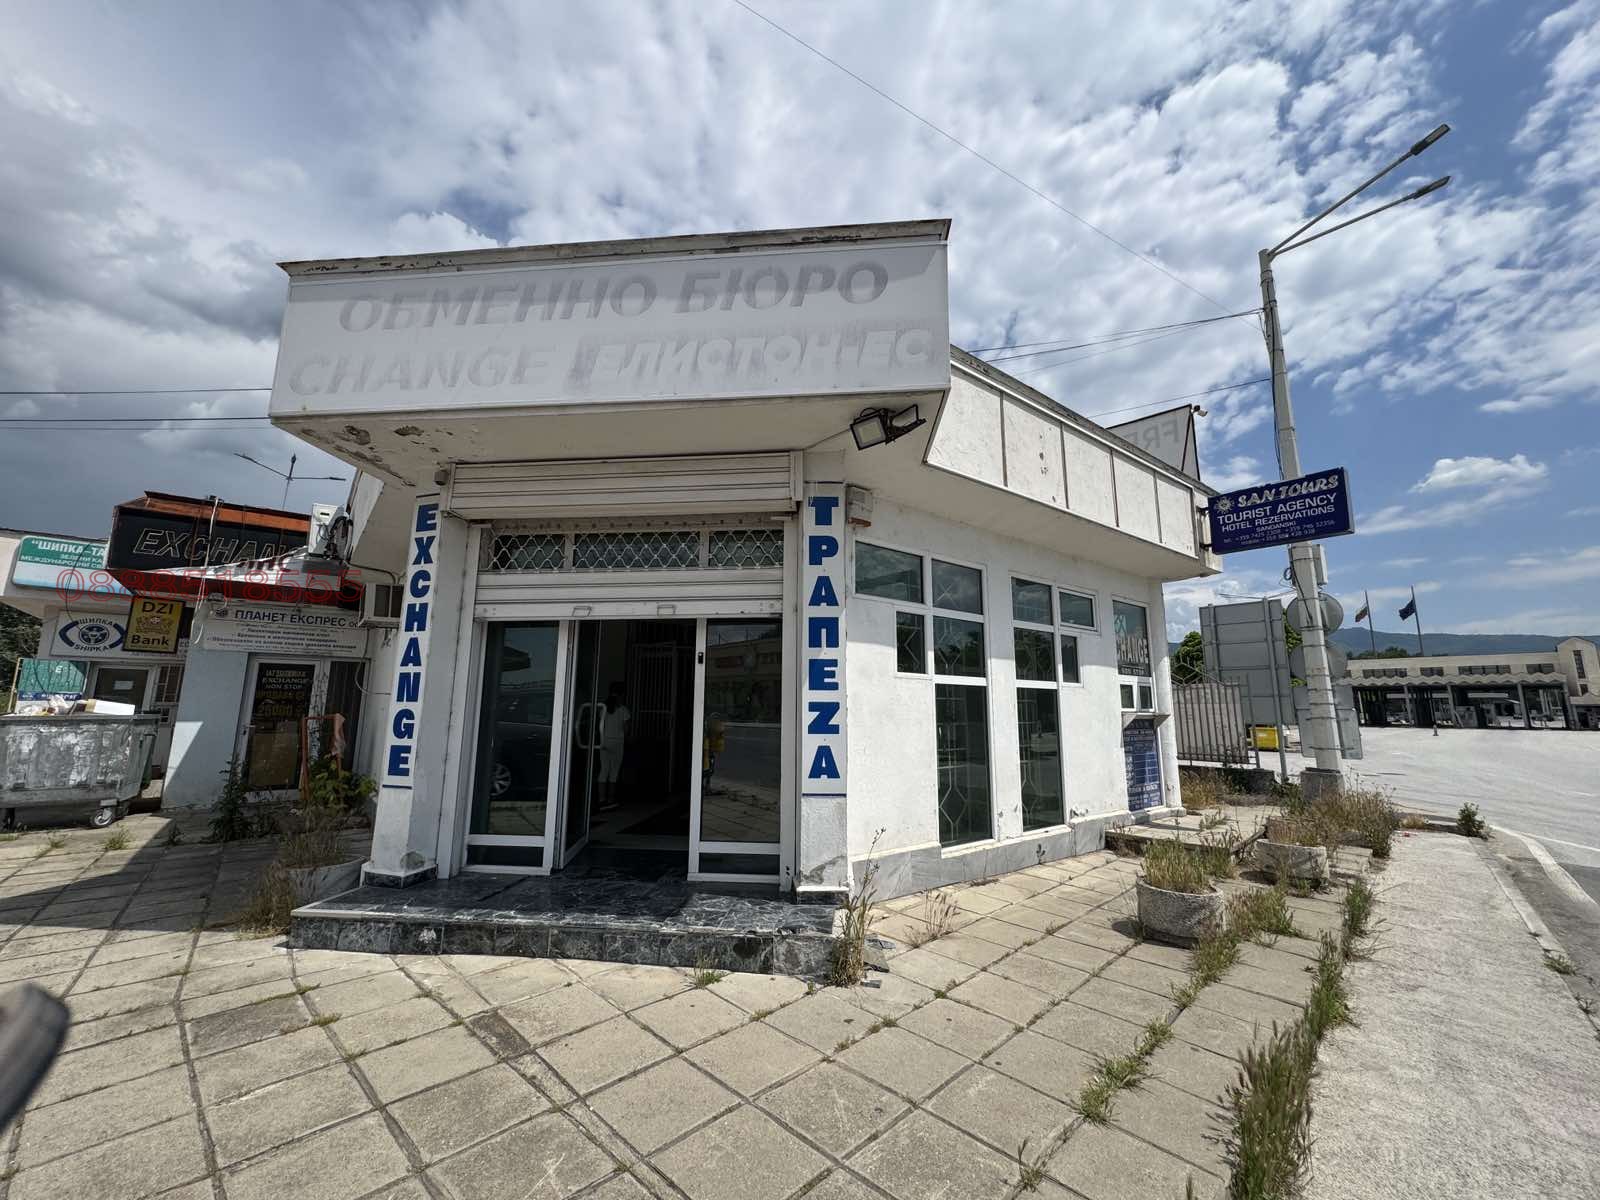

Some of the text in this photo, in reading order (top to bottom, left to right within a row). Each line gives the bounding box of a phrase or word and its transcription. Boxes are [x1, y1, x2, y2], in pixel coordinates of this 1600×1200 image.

[339, 261, 888, 332] ОБМЕННО БЮРО
[1237, 475, 1339, 507] SAN TOURS
[1217, 493, 1337, 524] TOURIST AGENCY
[1222, 505, 1335, 533] HOTEL REZERVATIONS
[1256, 521, 1297, 533] SANDANSKI
[142, 601, 174, 615] DZI
[79, 617, 114, 628] ШИПКА
[235, 609, 287, 623] ПЛАНЕТ
[290, 613, 346, 628] ЕКСПРЕС
[74, 643, 110, 652] SHIPKA
[131, 634, 170, 646] Bank
[387, 503, 439, 777] EXCHANGE
